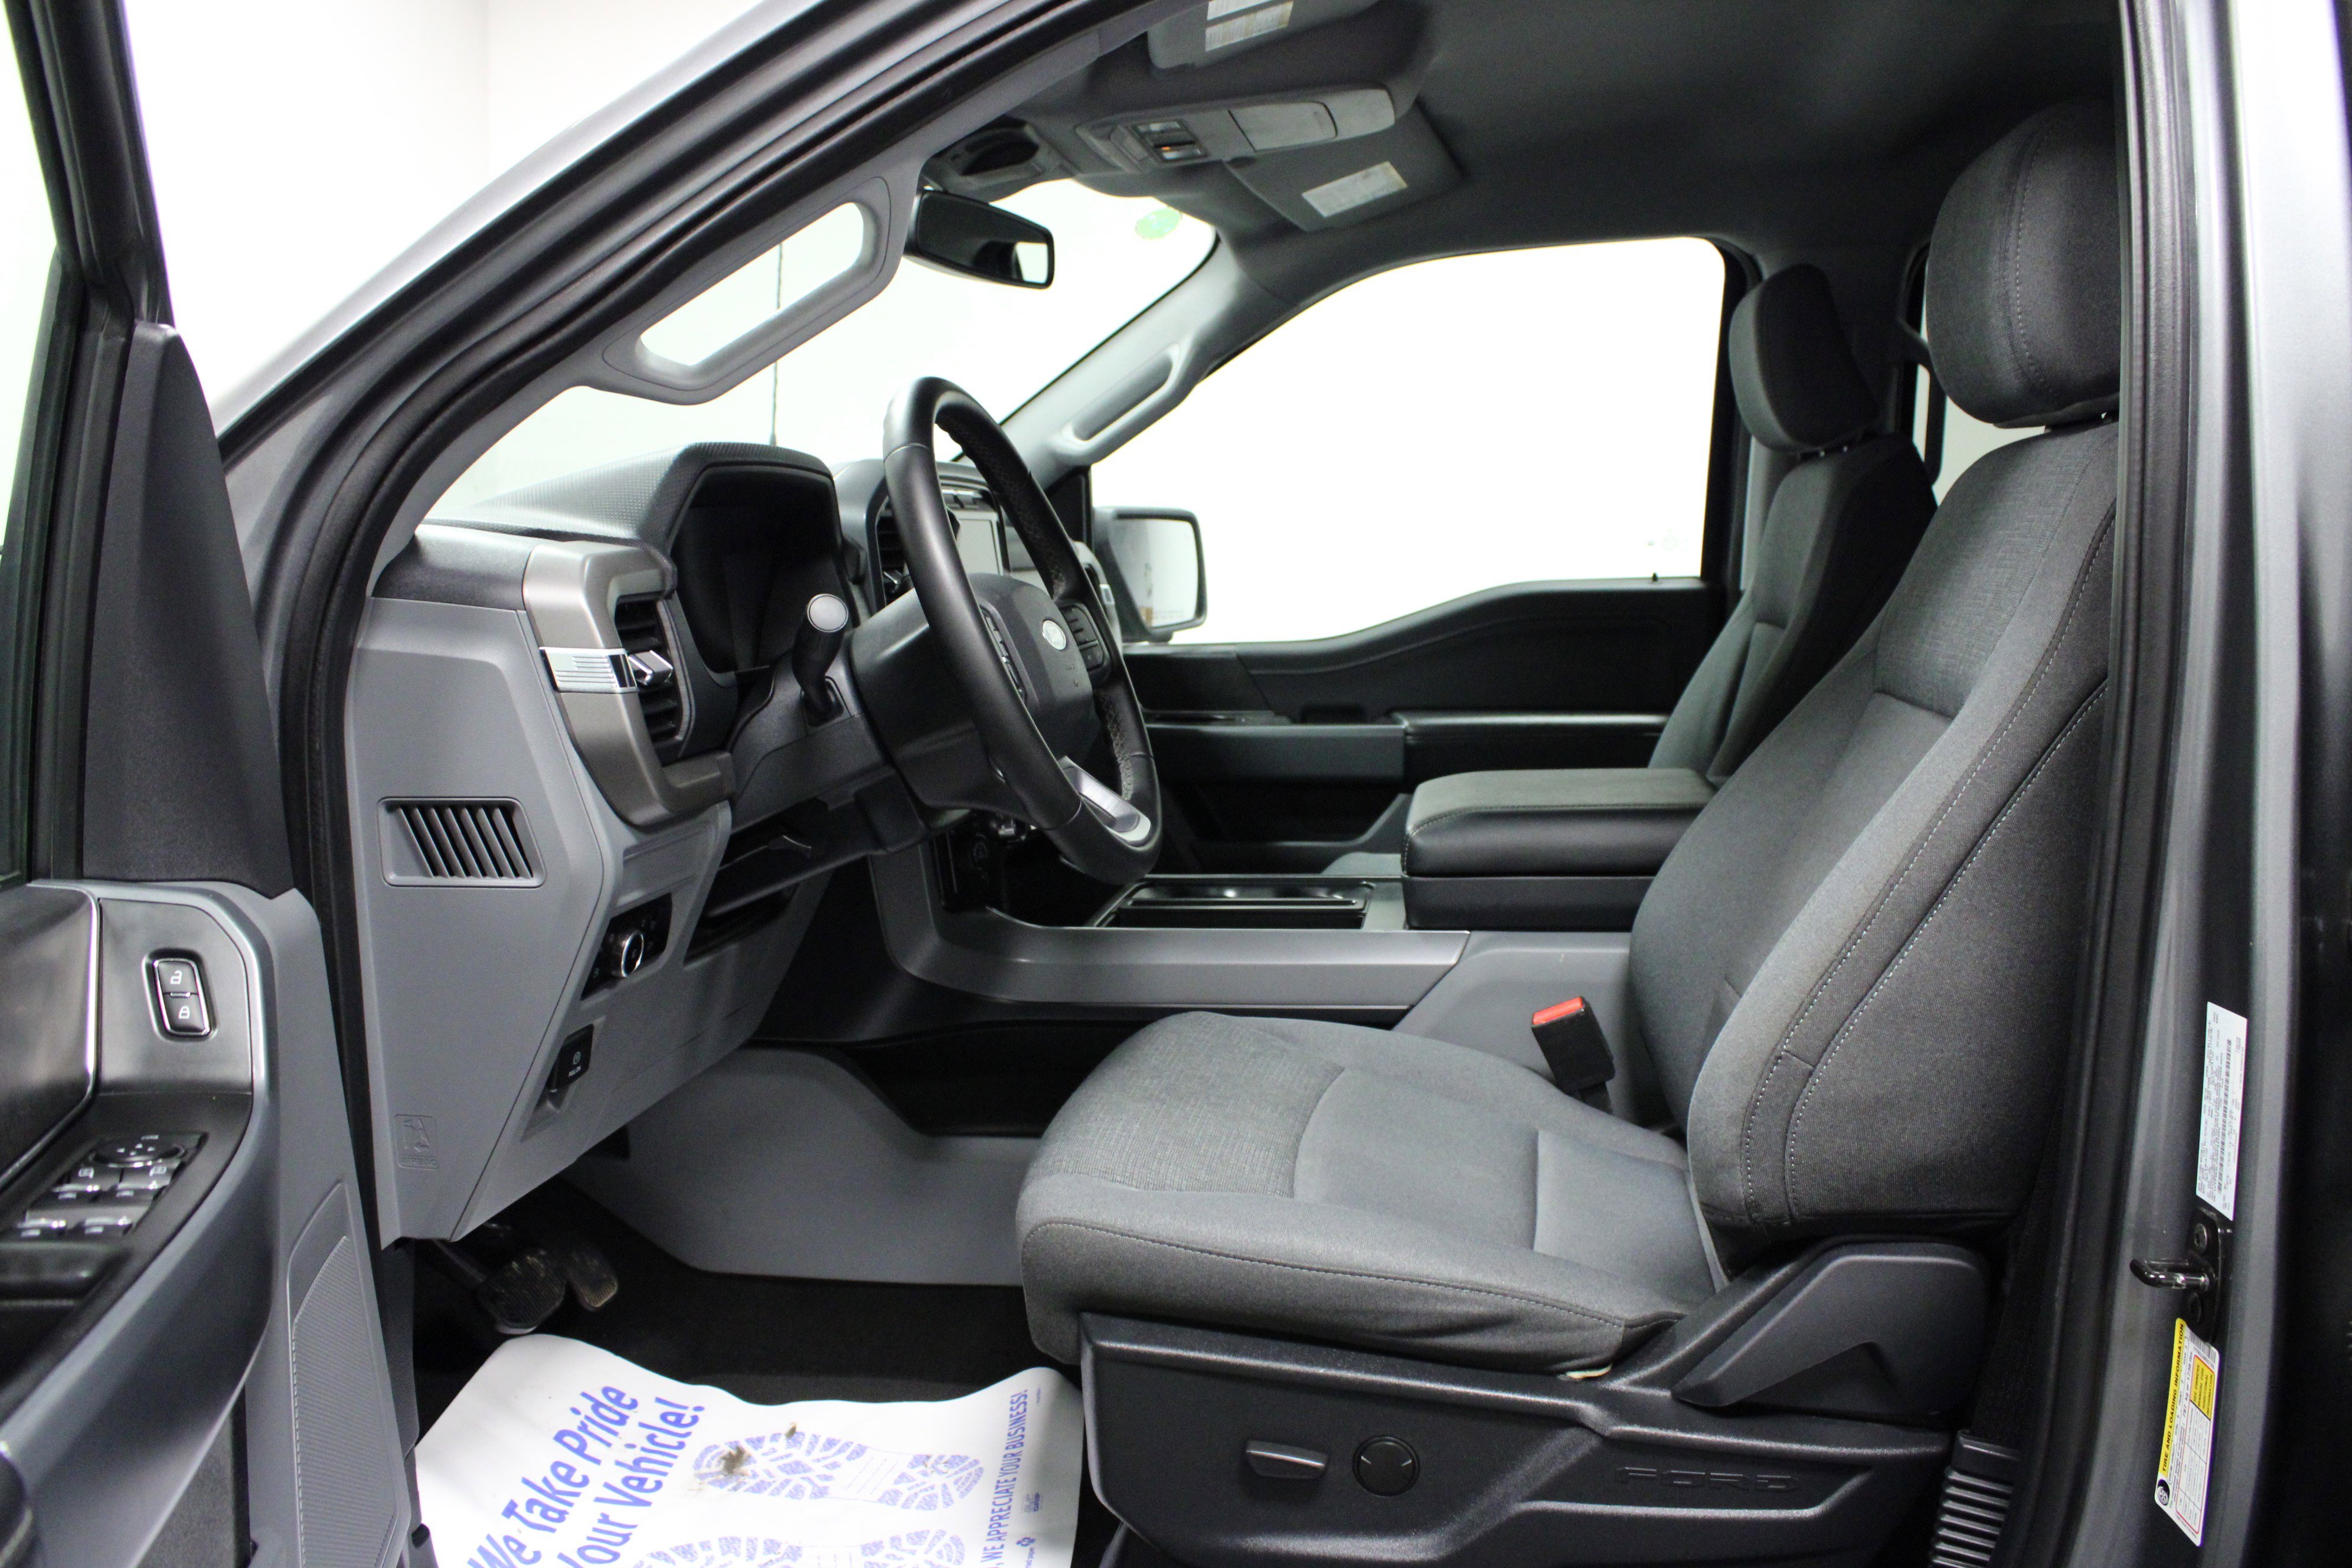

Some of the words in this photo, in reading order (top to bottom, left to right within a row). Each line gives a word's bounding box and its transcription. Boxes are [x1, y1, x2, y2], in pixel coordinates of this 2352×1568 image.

[2168, 1389, 2177, 1429] LOADING
[2174, 1323, 2184, 1387] INFORMATION
[553, 1386, 638, 1465] Pride
[1005, 1390, 1028, 1450] BUSINESS!
[594, 1397, 704, 1507] Vehicle!
[998, 1450, 1023, 1478] YOUR
[501, 1461, 589, 1533] Take
[986, 1478, 1017, 1541] APPRECIATE
[466, 1533, 542, 1568] We
[981, 1544, 1004, 1562] WE
